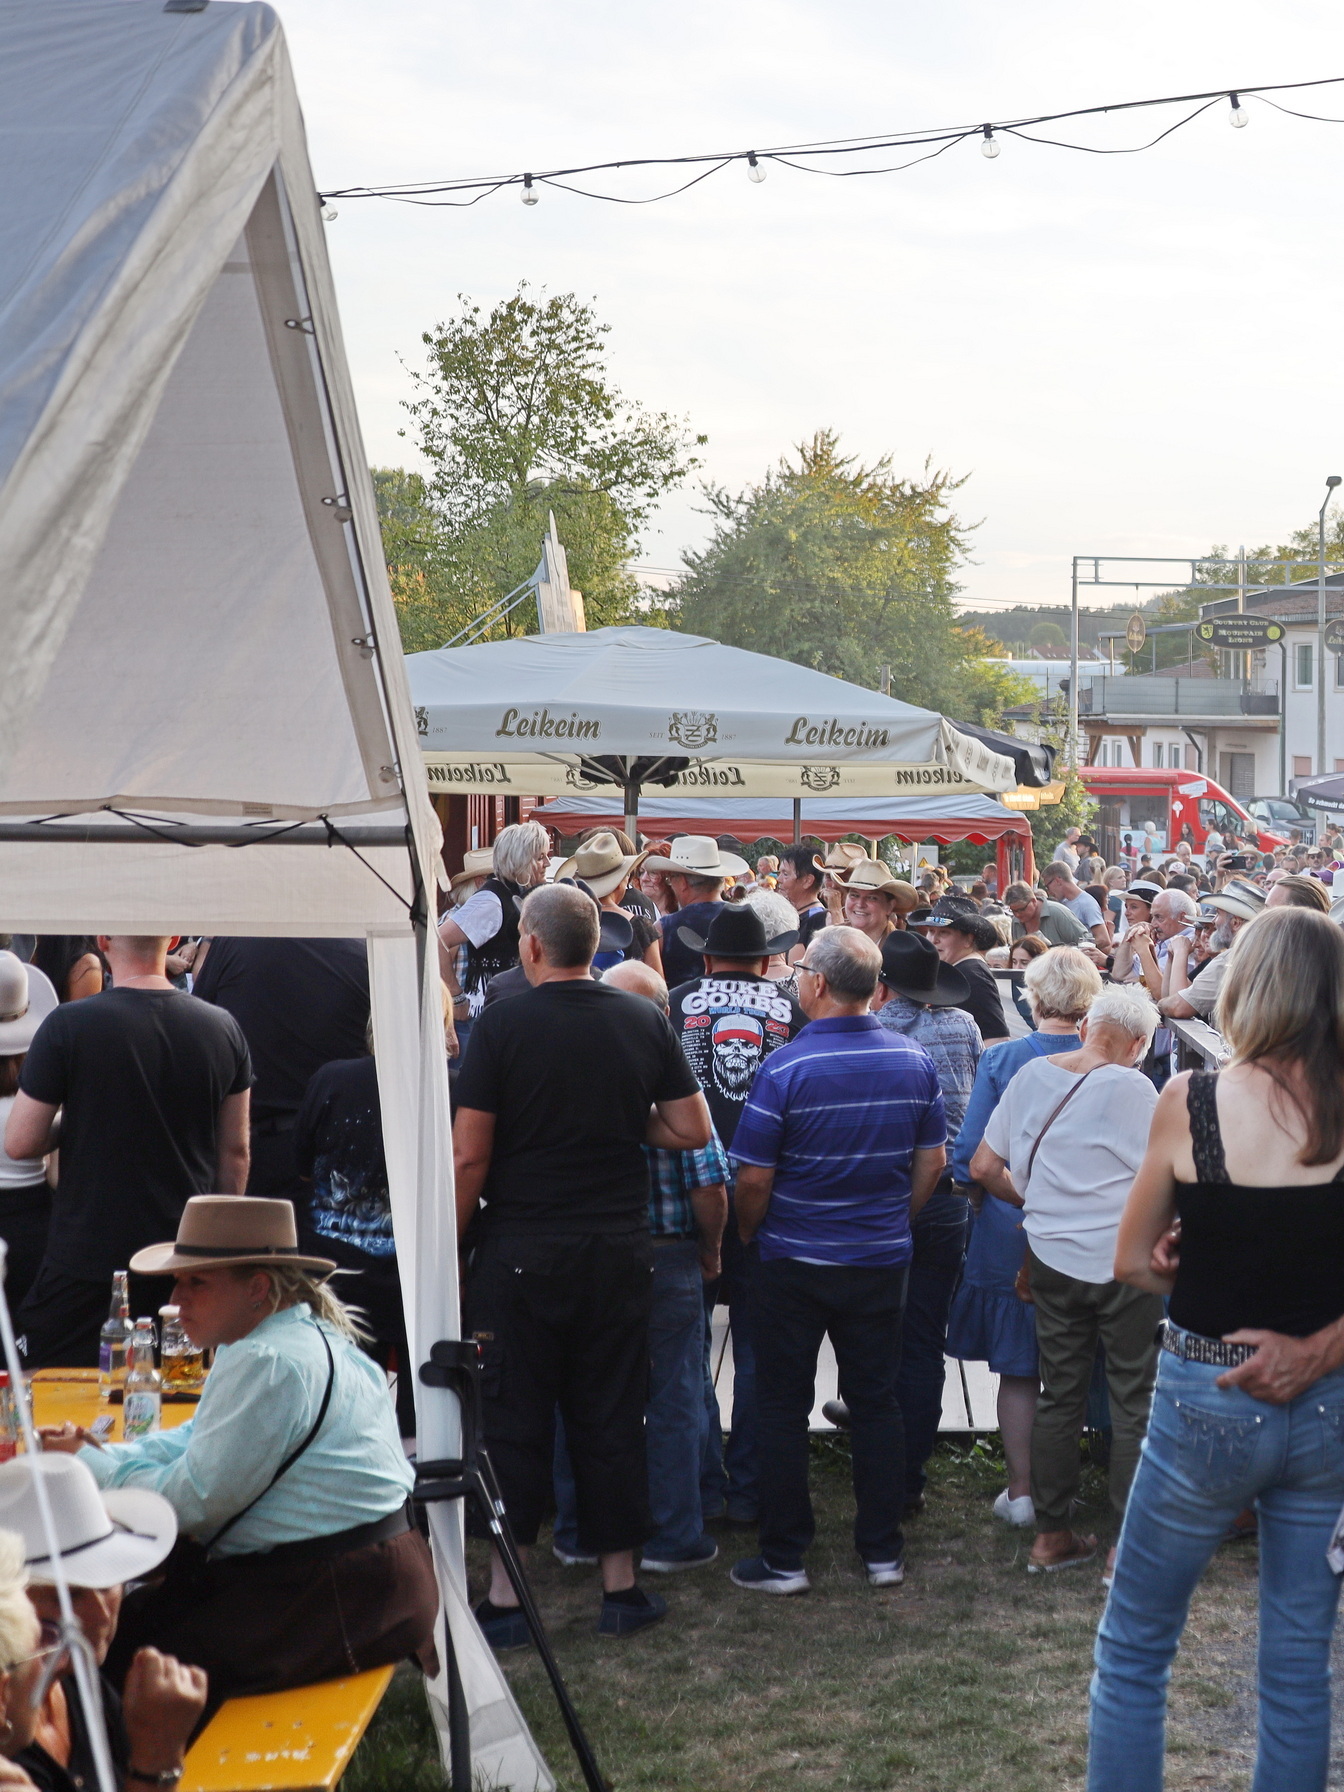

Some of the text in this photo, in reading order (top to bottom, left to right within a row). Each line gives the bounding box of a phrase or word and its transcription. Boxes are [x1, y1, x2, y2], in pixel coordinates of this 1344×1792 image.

[495, 707, 602, 742] Leikeim
[784, 716, 891, 750] Leikeim
[699, 978, 779, 998] LUKE
[681, 991, 792, 1024] COMBS
[709, 1006, 767, 1018] WORLD TOUR
[683, 1015, 711, 1029] 20
